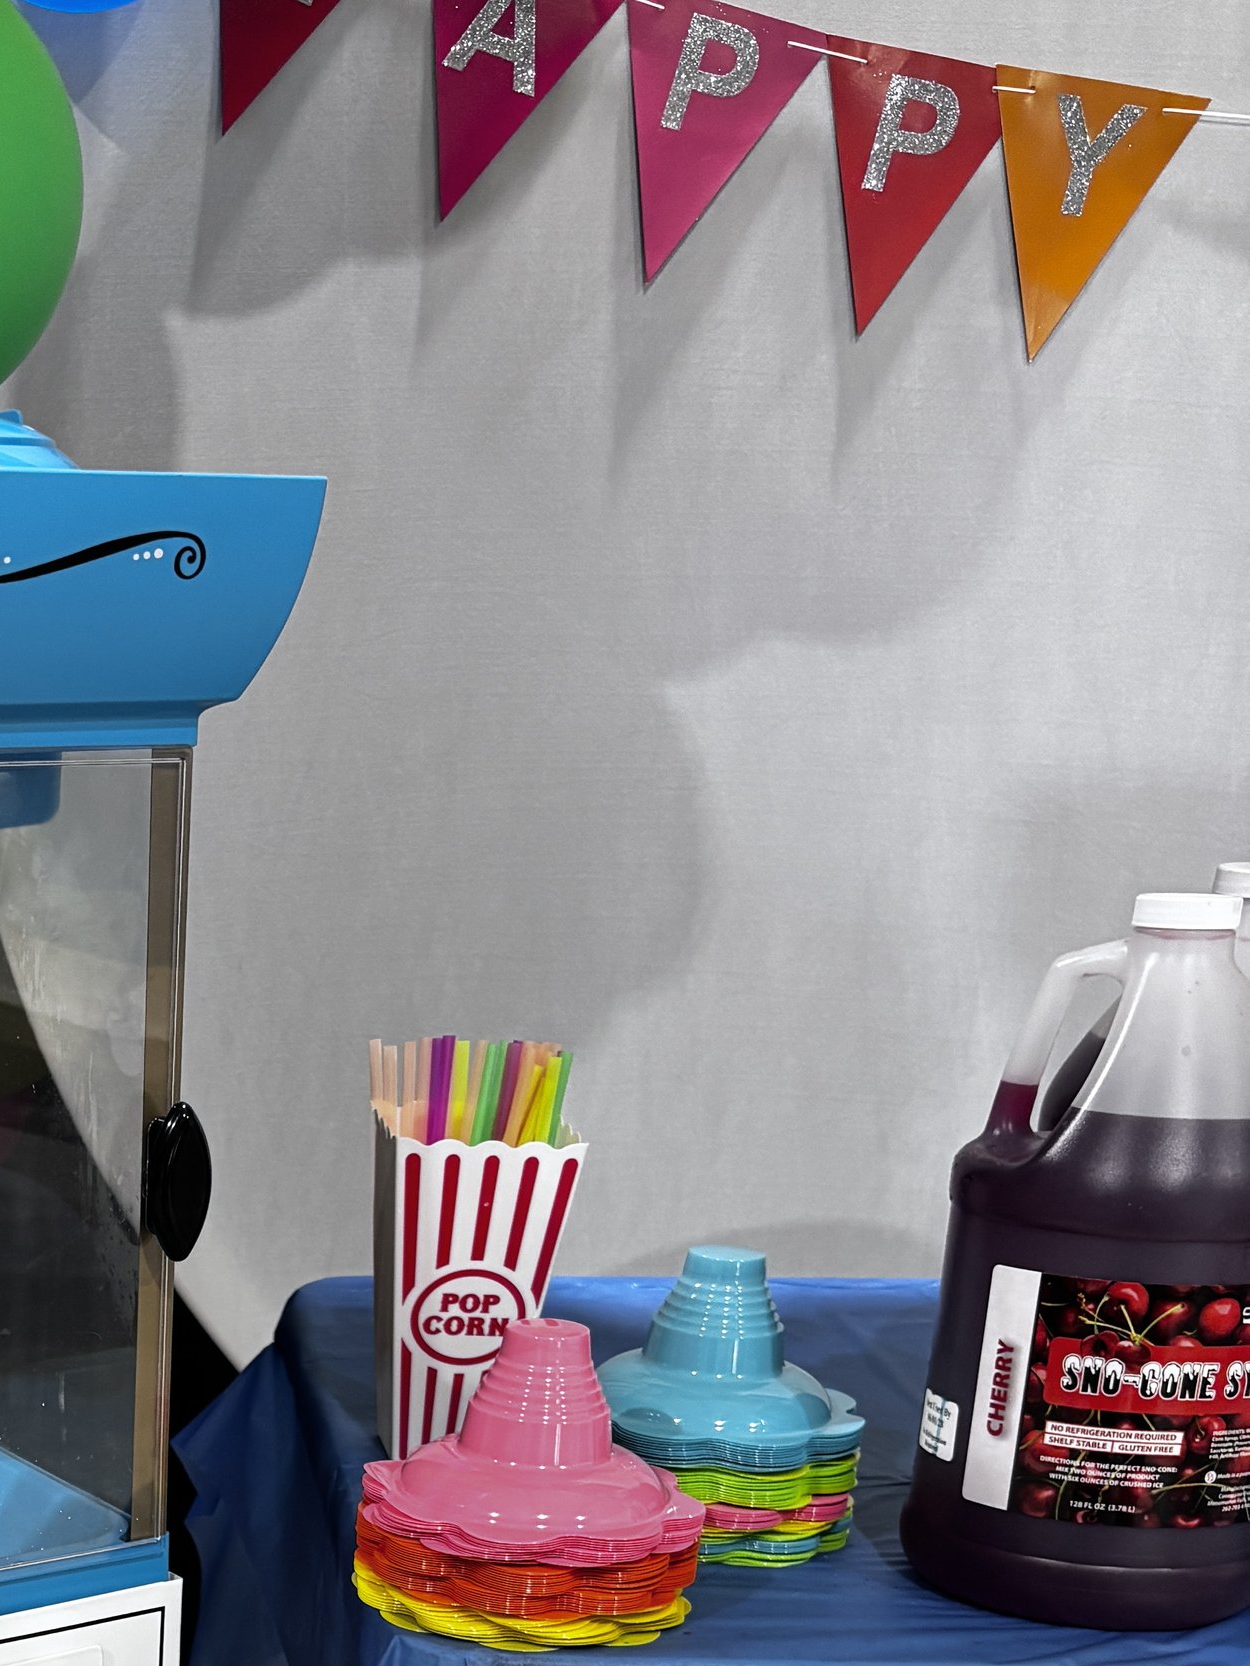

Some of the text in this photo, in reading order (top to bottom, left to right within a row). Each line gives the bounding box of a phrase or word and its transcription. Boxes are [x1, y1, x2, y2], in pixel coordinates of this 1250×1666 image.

[297, 0, 1147, 217] APPY
[439, 1292, 501, 1313] POP
[422, 1315, 510, 1336] CORN
[1061, 1353, 1220, 1400] SNO-CONE
[986, 1339, 1015, 1437] CHERRY
[1050, 1424, 1177, 1441] NO REFRIGERATION REQUIRED
[1048, 1436, 1108, 1449] SHELF STABLE
[1118, 1444, 1152, 1452] GLUTEN
[1040, 1455, 1080, 1466] DIRECTIONS
[1111, 1464, 1140, 1472] PERFECT
[1069, 1500, 1082, 1508] 128
